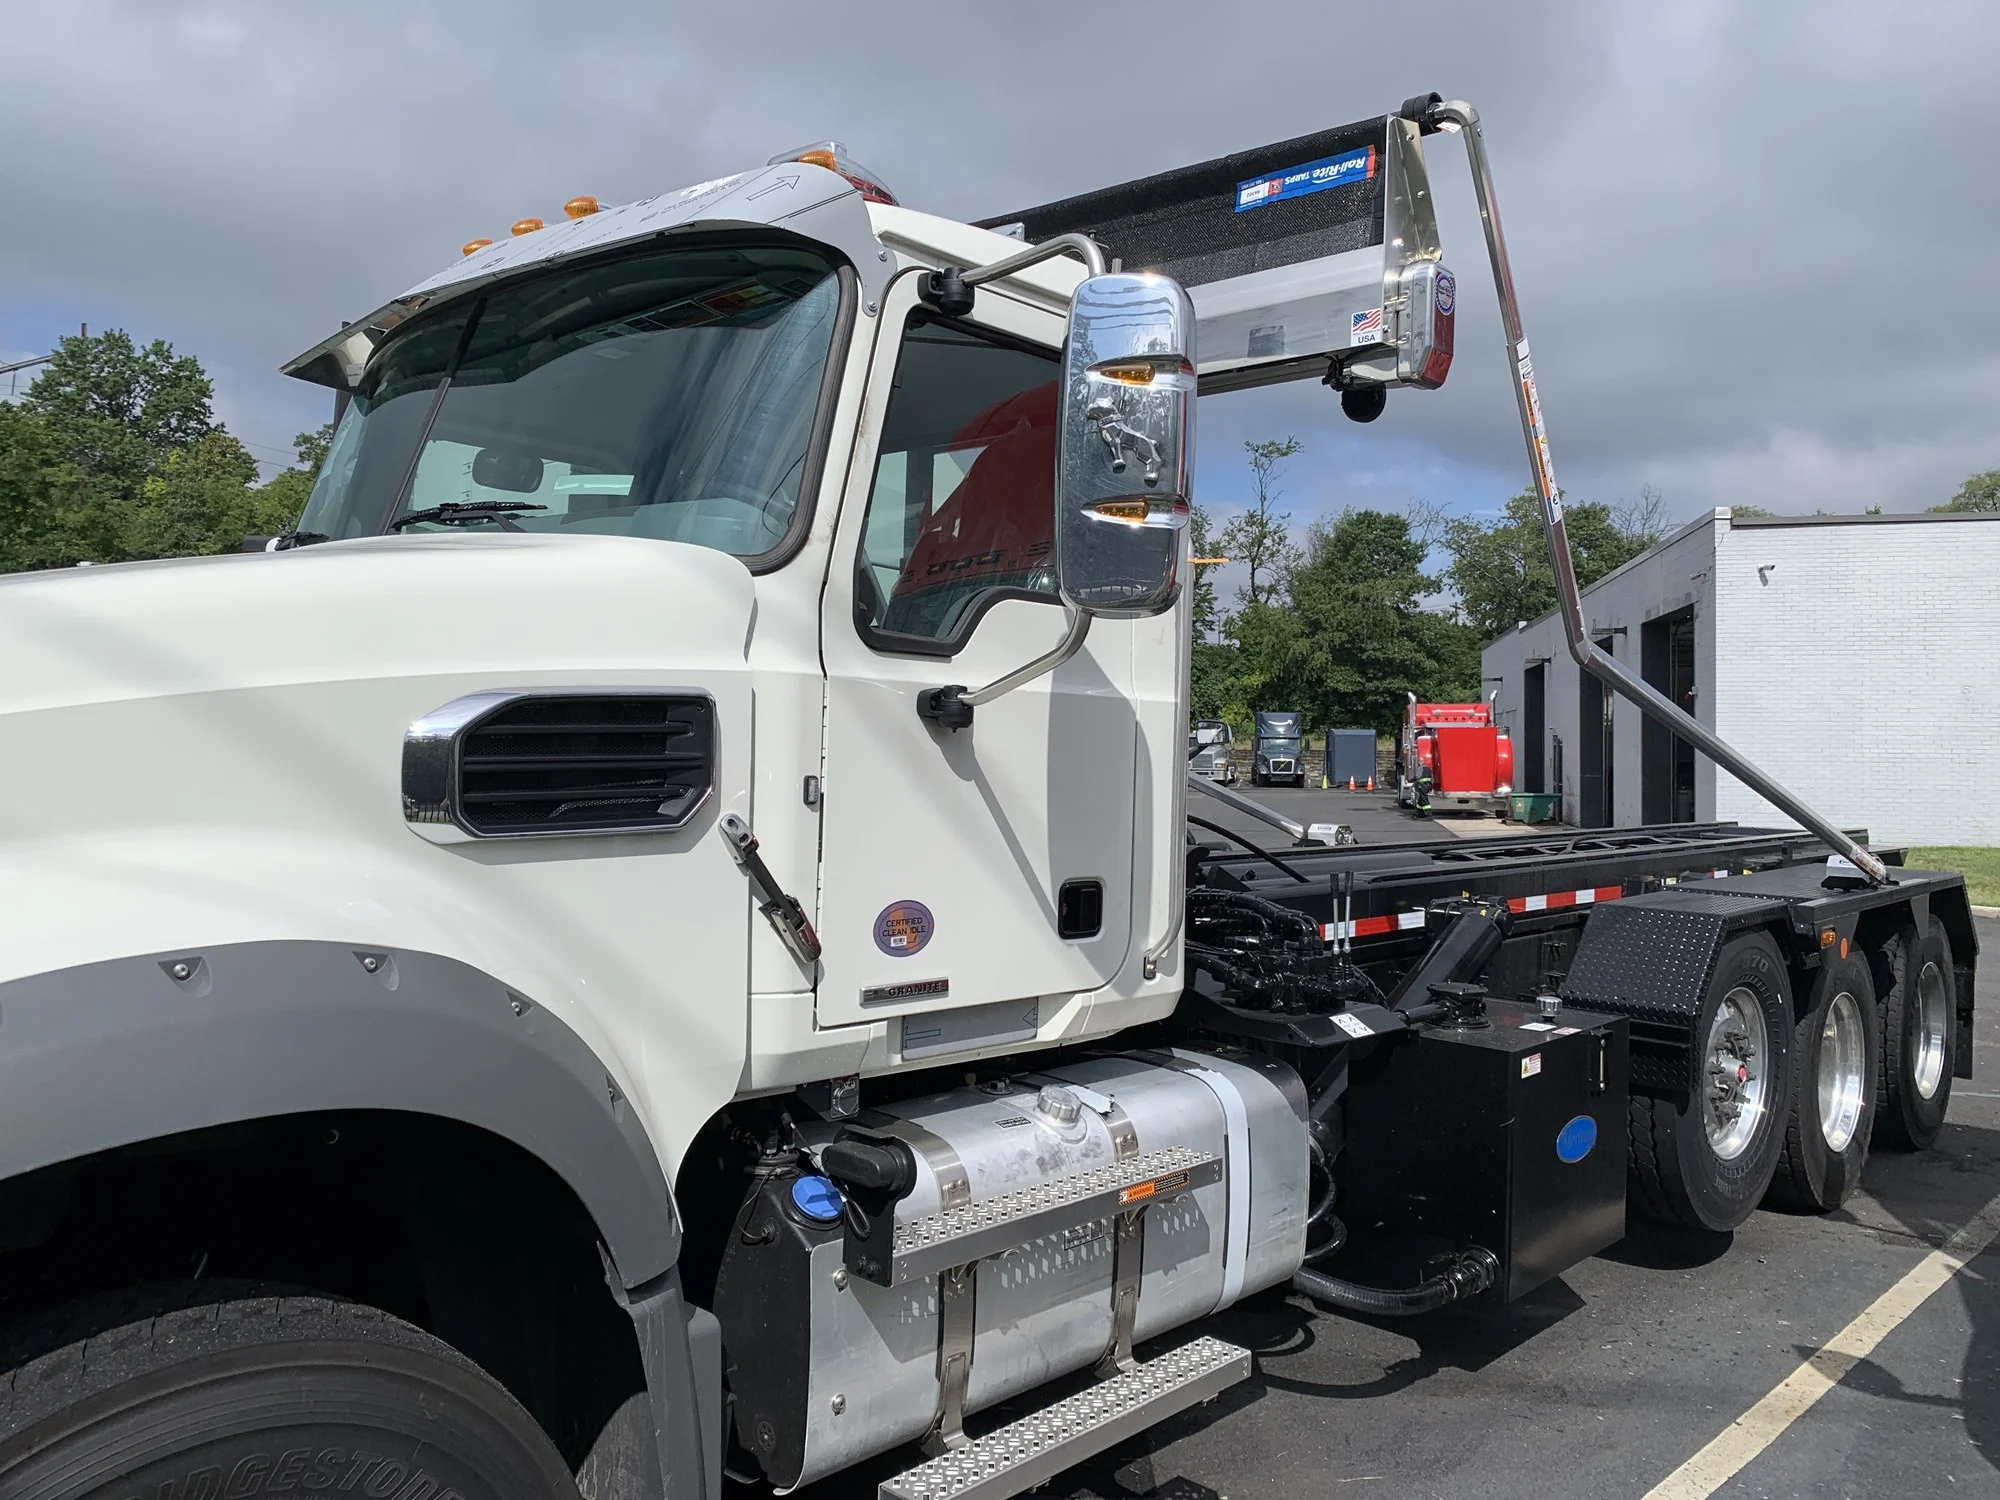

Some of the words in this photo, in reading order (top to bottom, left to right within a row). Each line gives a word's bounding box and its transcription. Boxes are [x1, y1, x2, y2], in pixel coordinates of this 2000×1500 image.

[1284, 172, 1310, 185] TARPS
[1358, 334, 1375, 343] USA
[885, 917, 923, 927] CERTIFIED
[882, 928, 907, 937] CLEAN
[910, 926, 926, 934] IDLE
[888, 982, 942, 997] GRANITE
[1133, 1185, 1153, 1196] WARNING
